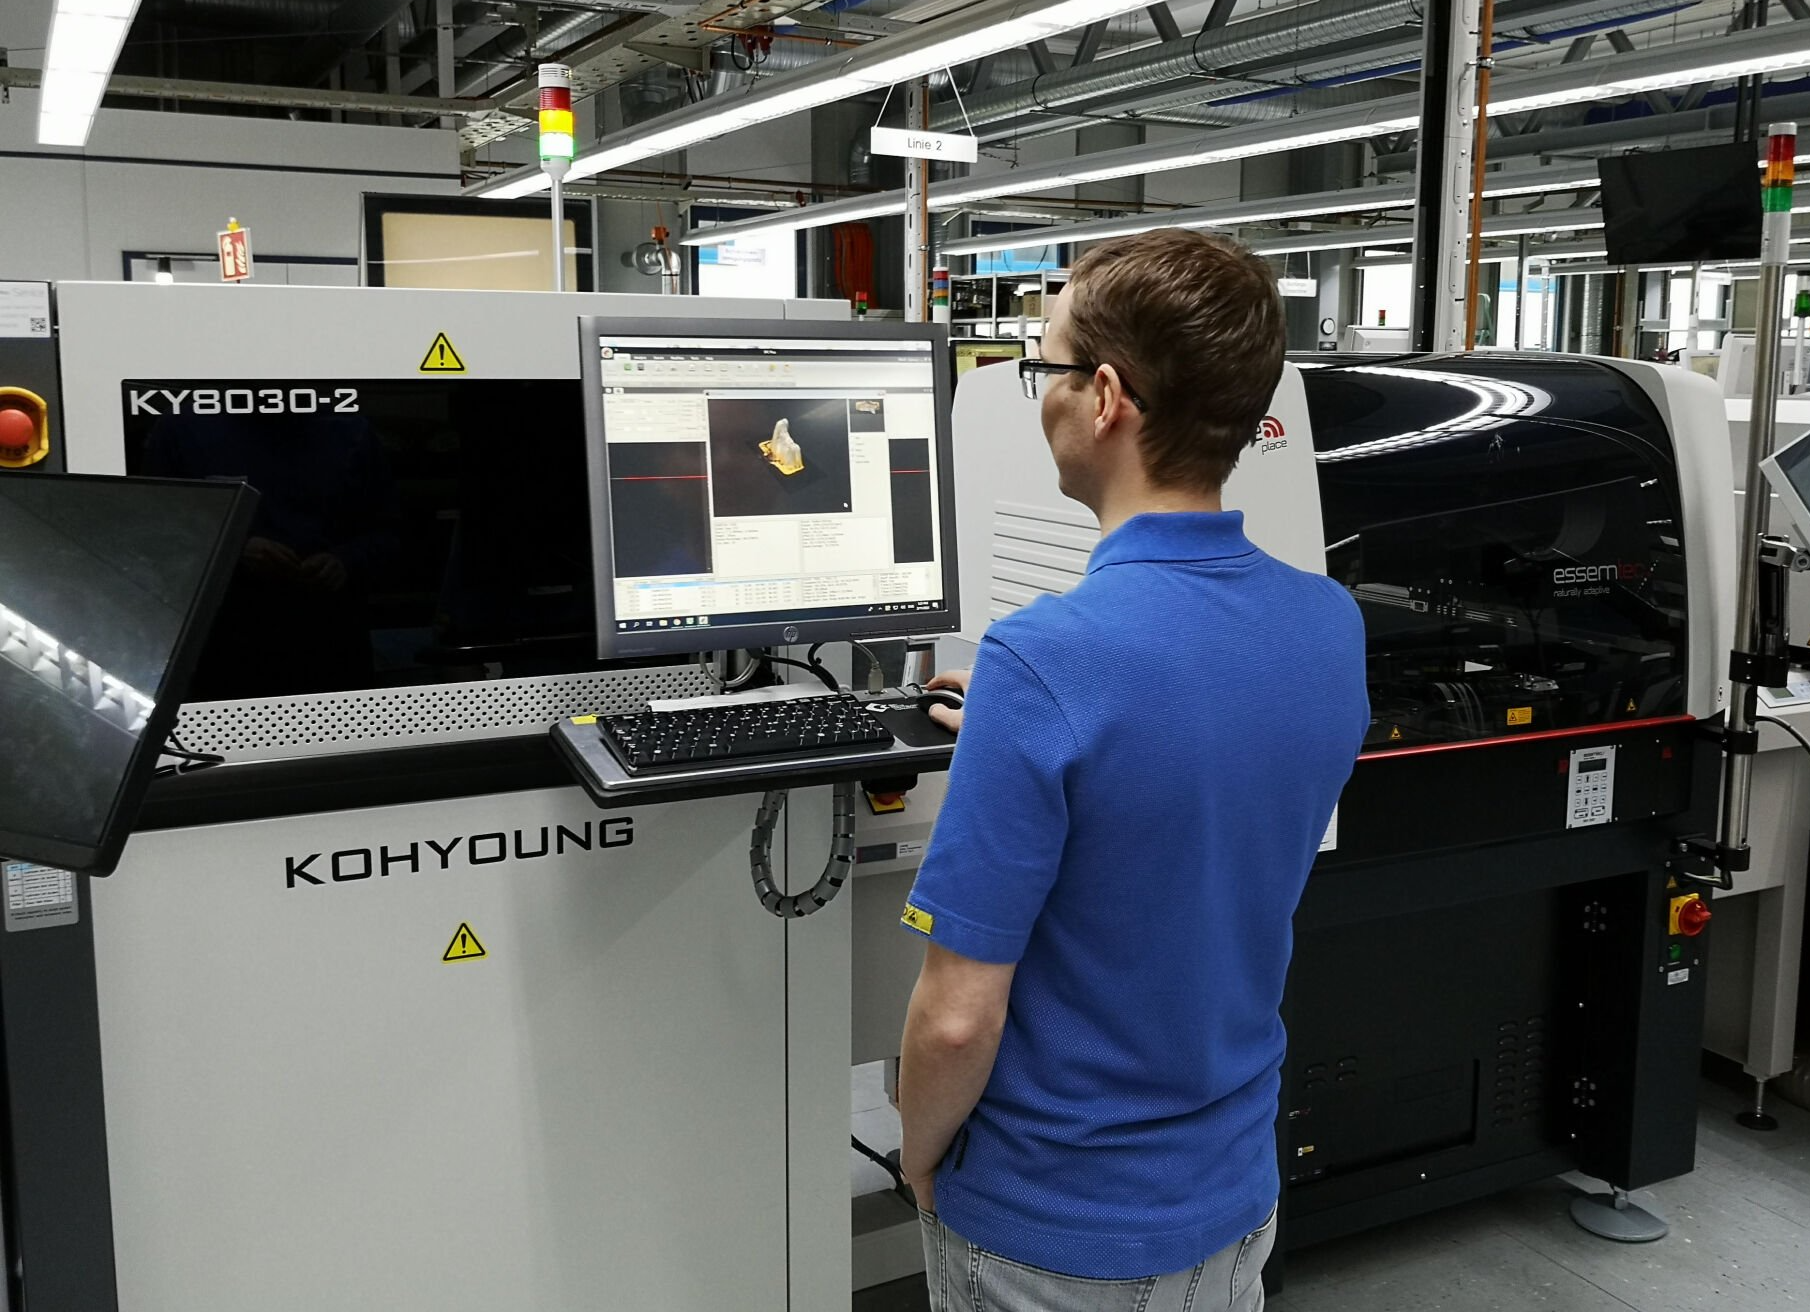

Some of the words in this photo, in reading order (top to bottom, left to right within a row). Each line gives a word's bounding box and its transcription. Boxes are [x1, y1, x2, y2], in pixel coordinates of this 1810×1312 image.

[907, 137, 932, 151] Linie
[936, 140, 943, 151] 2
[129, 388, 360, 416] KY8030-2
[1261, 439, 1288, 456] place
[285, 816, 634, 889] KOHYOUNG
